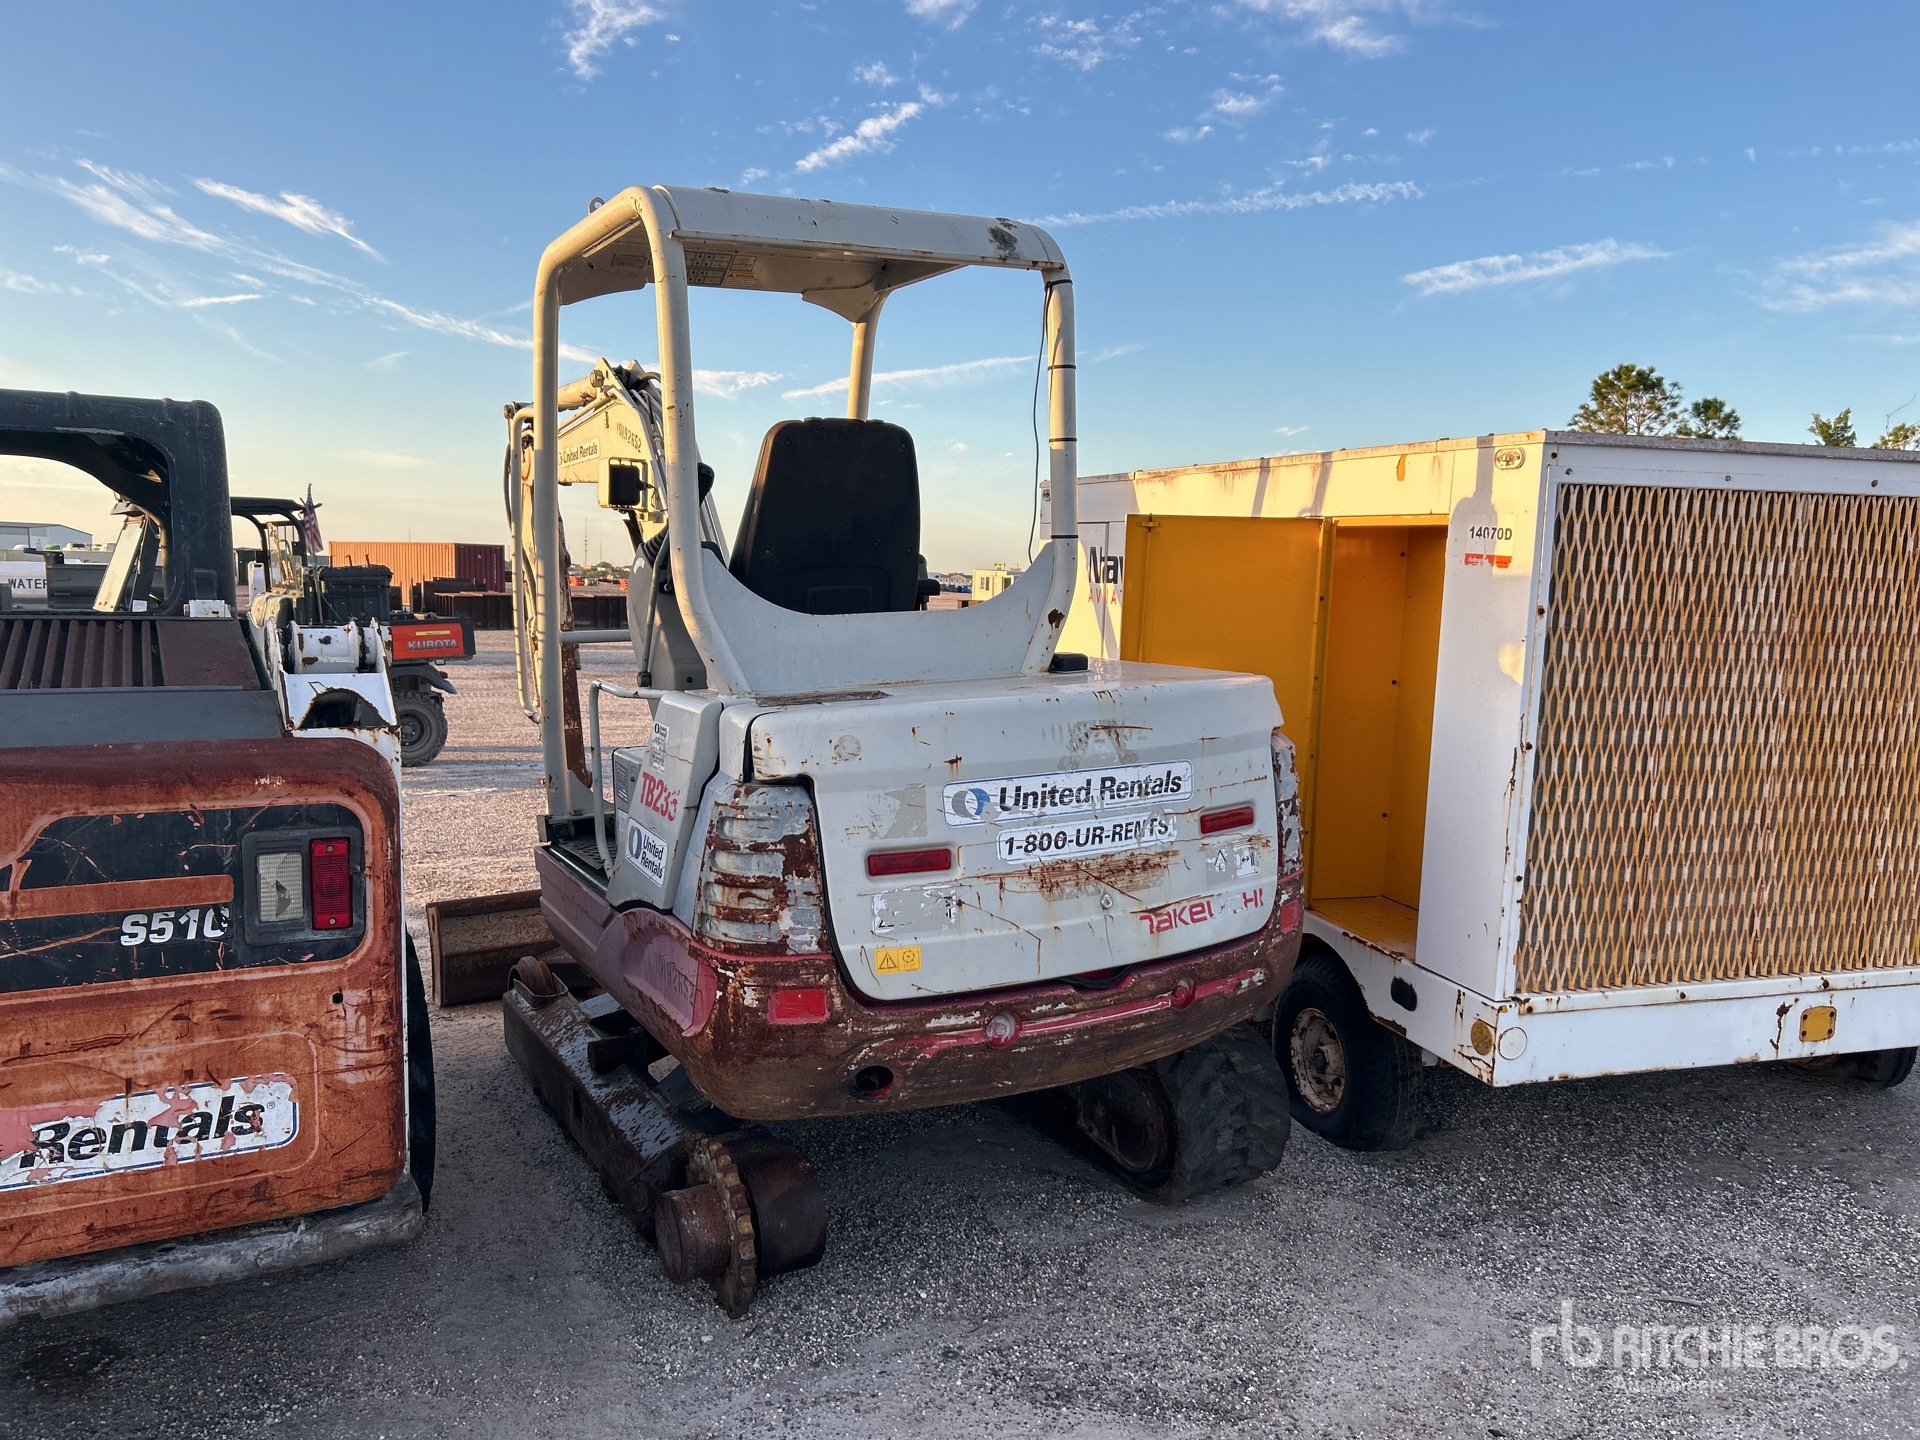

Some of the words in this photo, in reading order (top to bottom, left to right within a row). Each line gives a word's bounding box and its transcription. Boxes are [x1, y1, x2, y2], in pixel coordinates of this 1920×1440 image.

[562, 446, 579, 464] United
[579, 442, 598, 459] Rentals
[1469, 526, 1513, 540] 14070D
[408, 639, 458, 650] KUBOTA
[999, 778, 1093, 812] United
[1099, 770, 1183, 802] Rentals
[643, 834, 664, 862] United
[1004, 817, 1170, 857] 1-800-UR-RENTS
[640, 851, 664, 880] Rentals
[120, 905, 230, 946] S510
